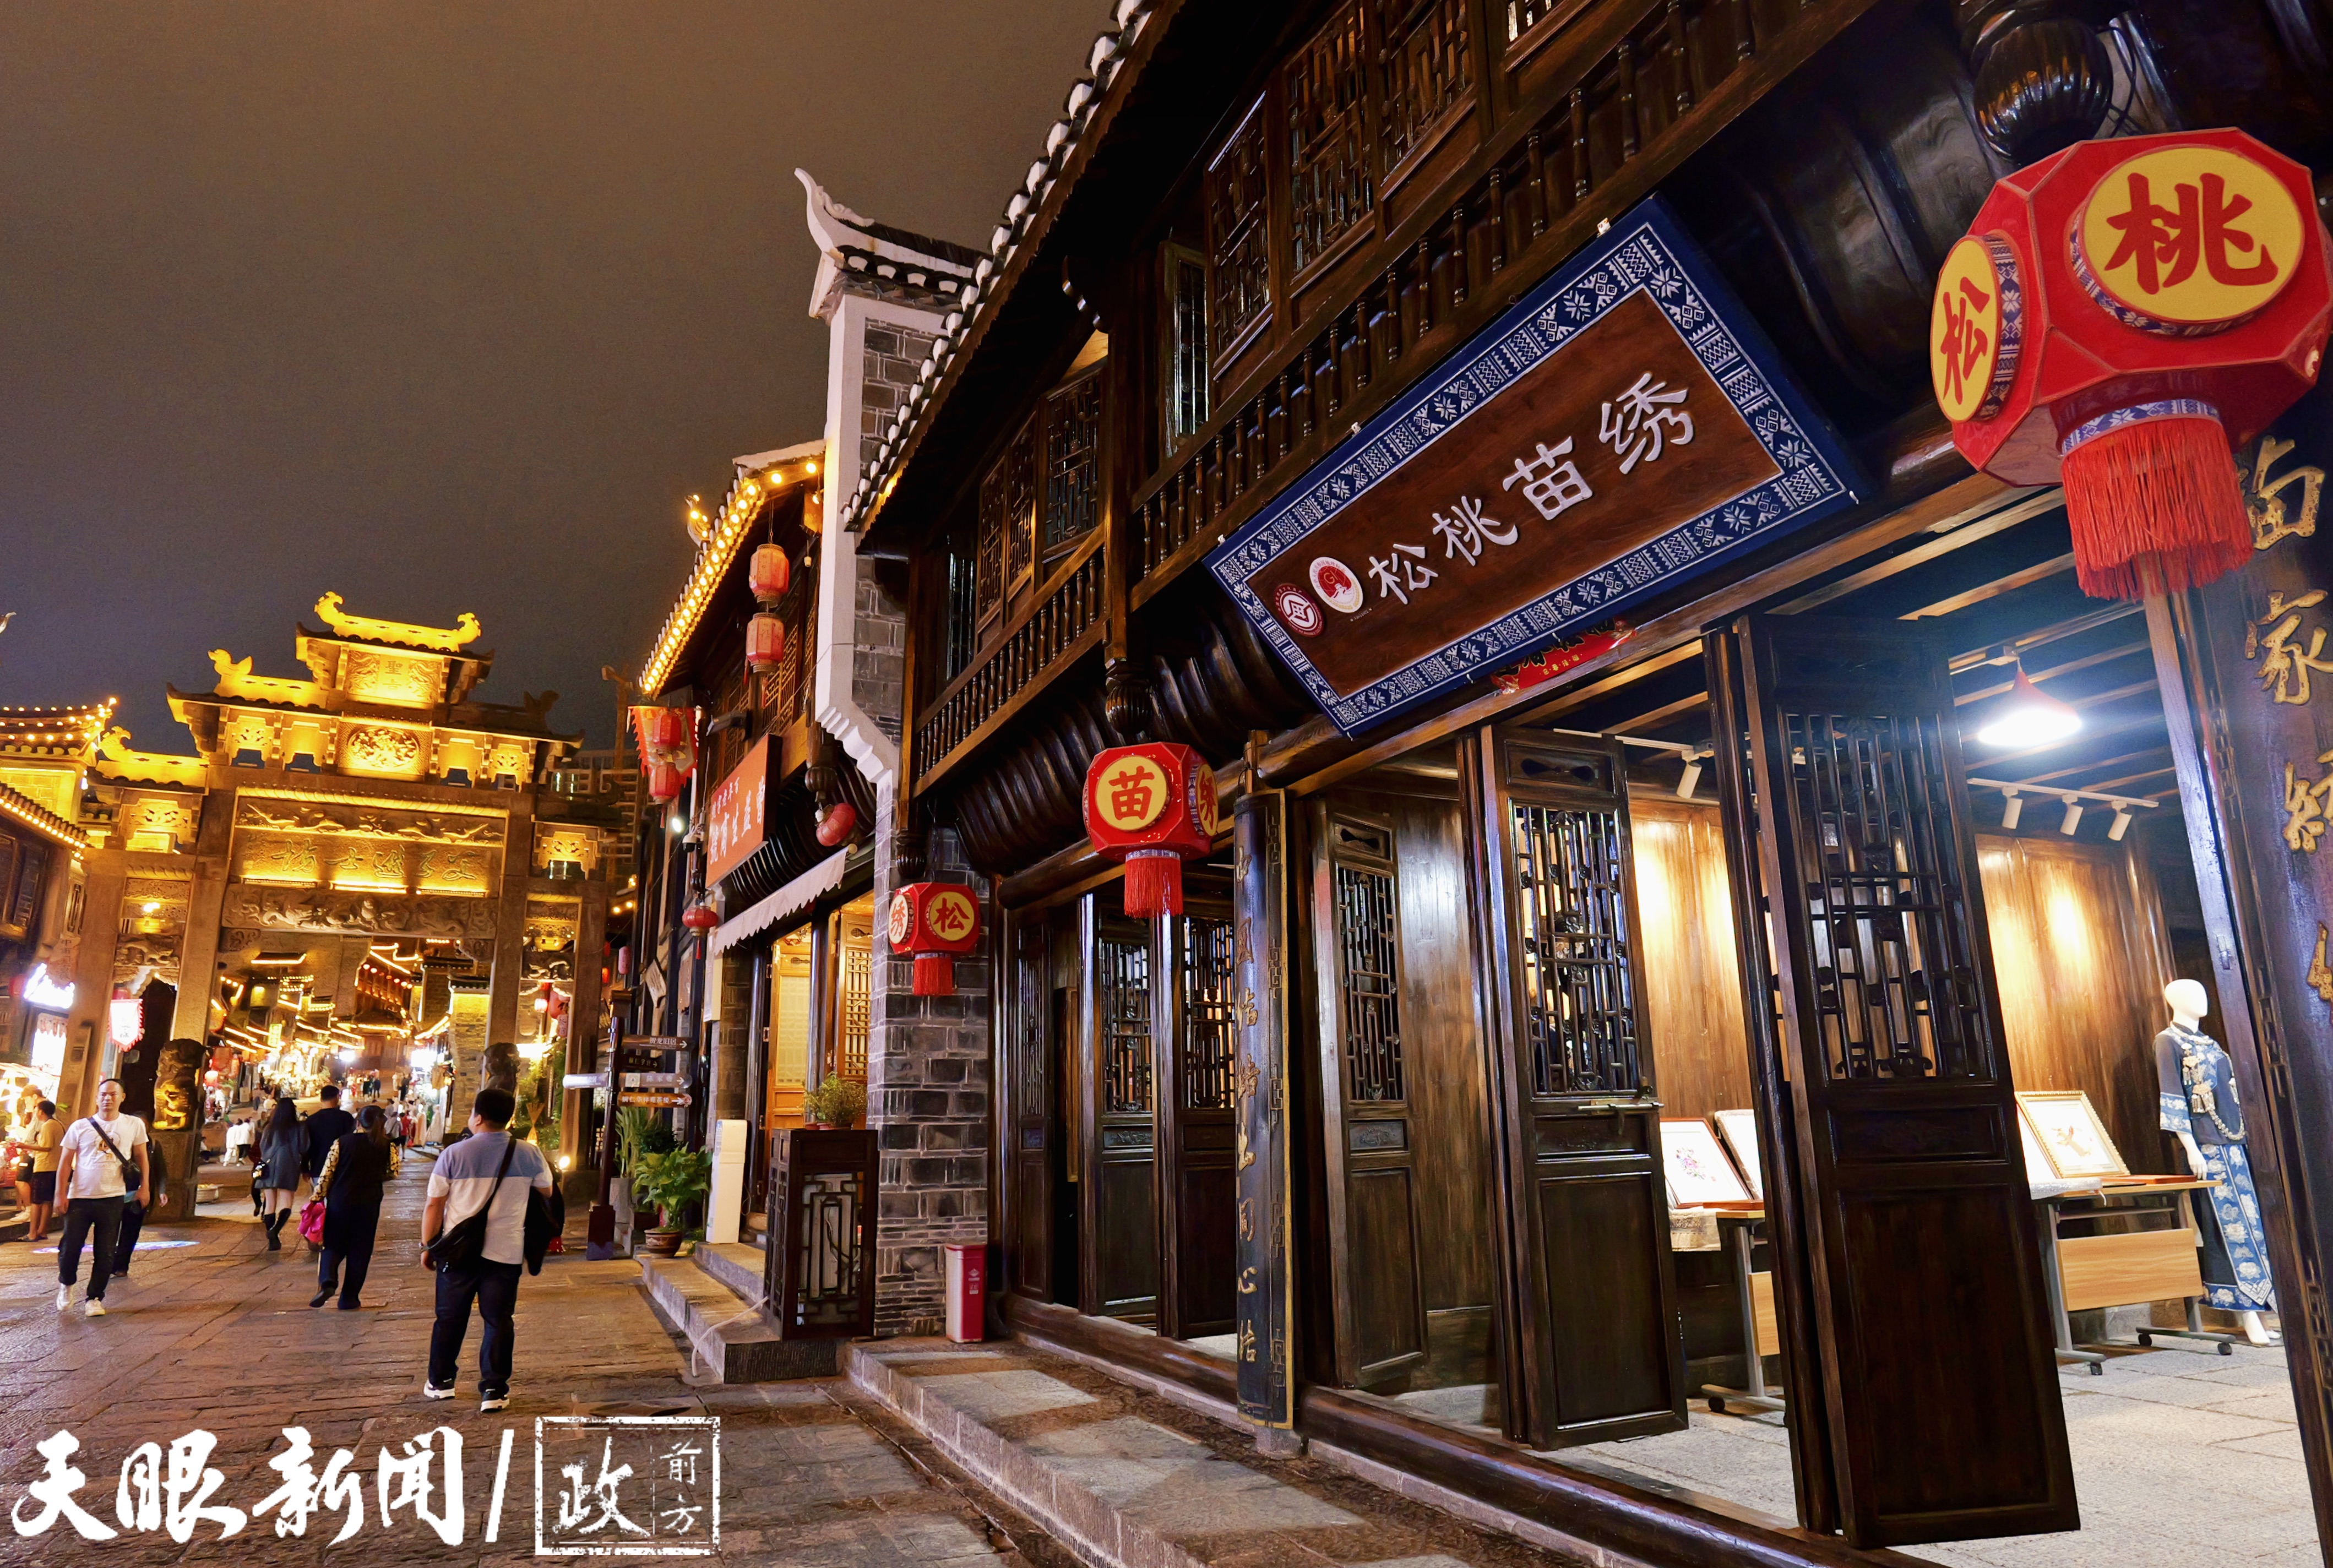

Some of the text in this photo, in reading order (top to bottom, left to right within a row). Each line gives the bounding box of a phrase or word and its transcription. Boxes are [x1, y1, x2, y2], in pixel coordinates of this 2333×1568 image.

[2103, 171, 2280, 295] 桃
[1940, 276, 1991, 405] 松
[1367, 371, 1696, 606] 松桃苗绣
[1323, 570, 1339, 584] GI
[1108, 765, 1155, 821] 苗
[1199, 770, 1216, 830] 绣
[890, 899, 906, 937] 绣
[933, 897, 970, 934] 松
